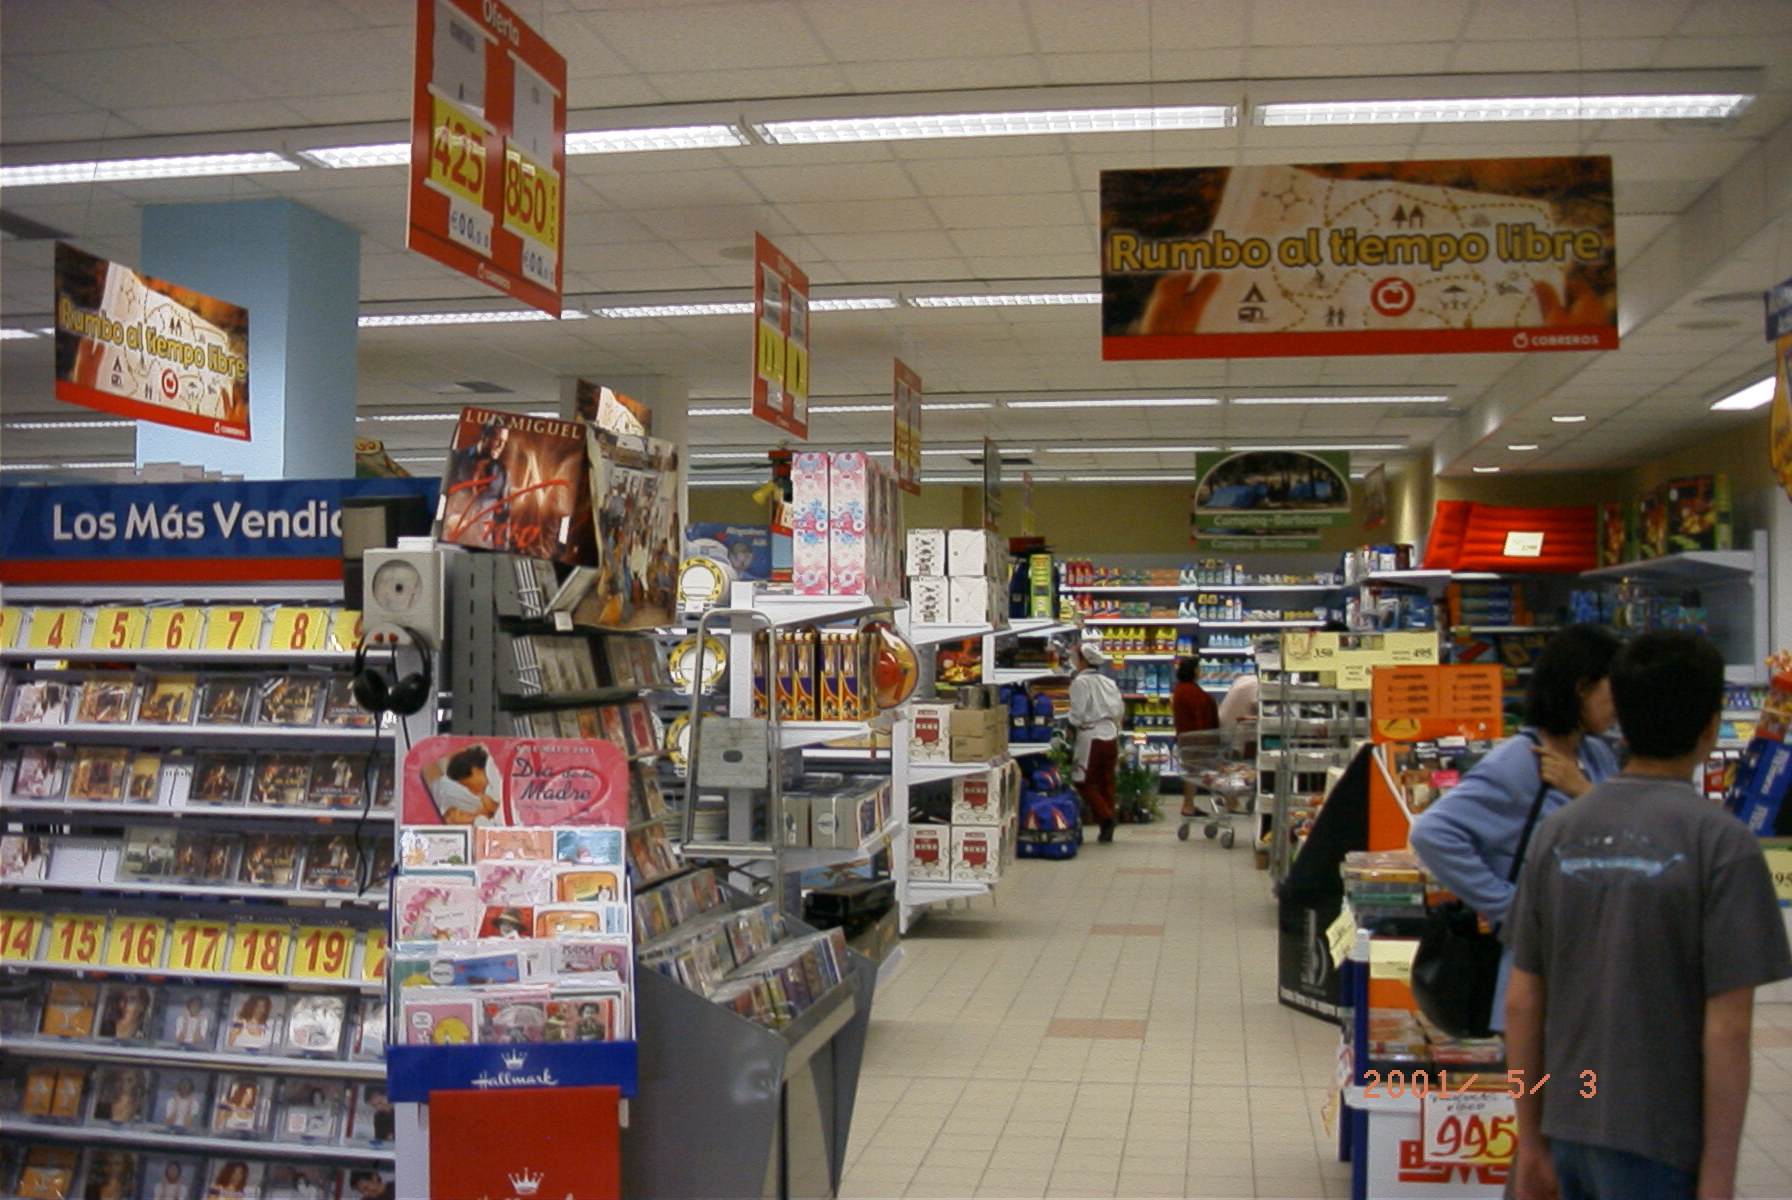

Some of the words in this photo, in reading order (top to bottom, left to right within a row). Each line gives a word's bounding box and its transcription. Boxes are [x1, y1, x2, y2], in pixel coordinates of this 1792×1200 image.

[482, 0, 521, 47] Oferta
[432, 118, 483, 194] 425
[505, 154, 547, 234] 850
[1108, 229, 1272, 272] Rumbo
[1277, 224, 1322, 268] al
[1328, 225, 1489, 272] tiempo
[1494, 220, 1604, 264] libre
[58, 296, 126, 348] Rumbo
[126, 320, 145, 351] al
[145, 324, 206, 368] tiempo
[206, 343, 248, 379] libre
[1530, 333, 1601, 348] COBREROS
[465, 409, 506, 428] LUIS
[507, 415, 582, 440] MIGUEL
[52, 502, 117, 542] Los
[125, 502, 205, 541] Más
[47, 611, 65, 649] 4
[109, 611, 129, 650] 5
[165, 612, 185, 650] 6
[227, 611, 245, 649] 7
[289, 612, 310, 650] 8
[519, 780, 592, 802] Madre
[0, 916, 36, 957] 14
[60, 920, 98, 962] 15
[120, 923, 158, 965] 16
[180, 926, 220, 969] 17
[242, 929, 282, 972] 18
[304, 931, 346, 974] 19
[471, 1067, 559, 1090] Hallmark
[1429, 1114, 1520, 1160] 995
